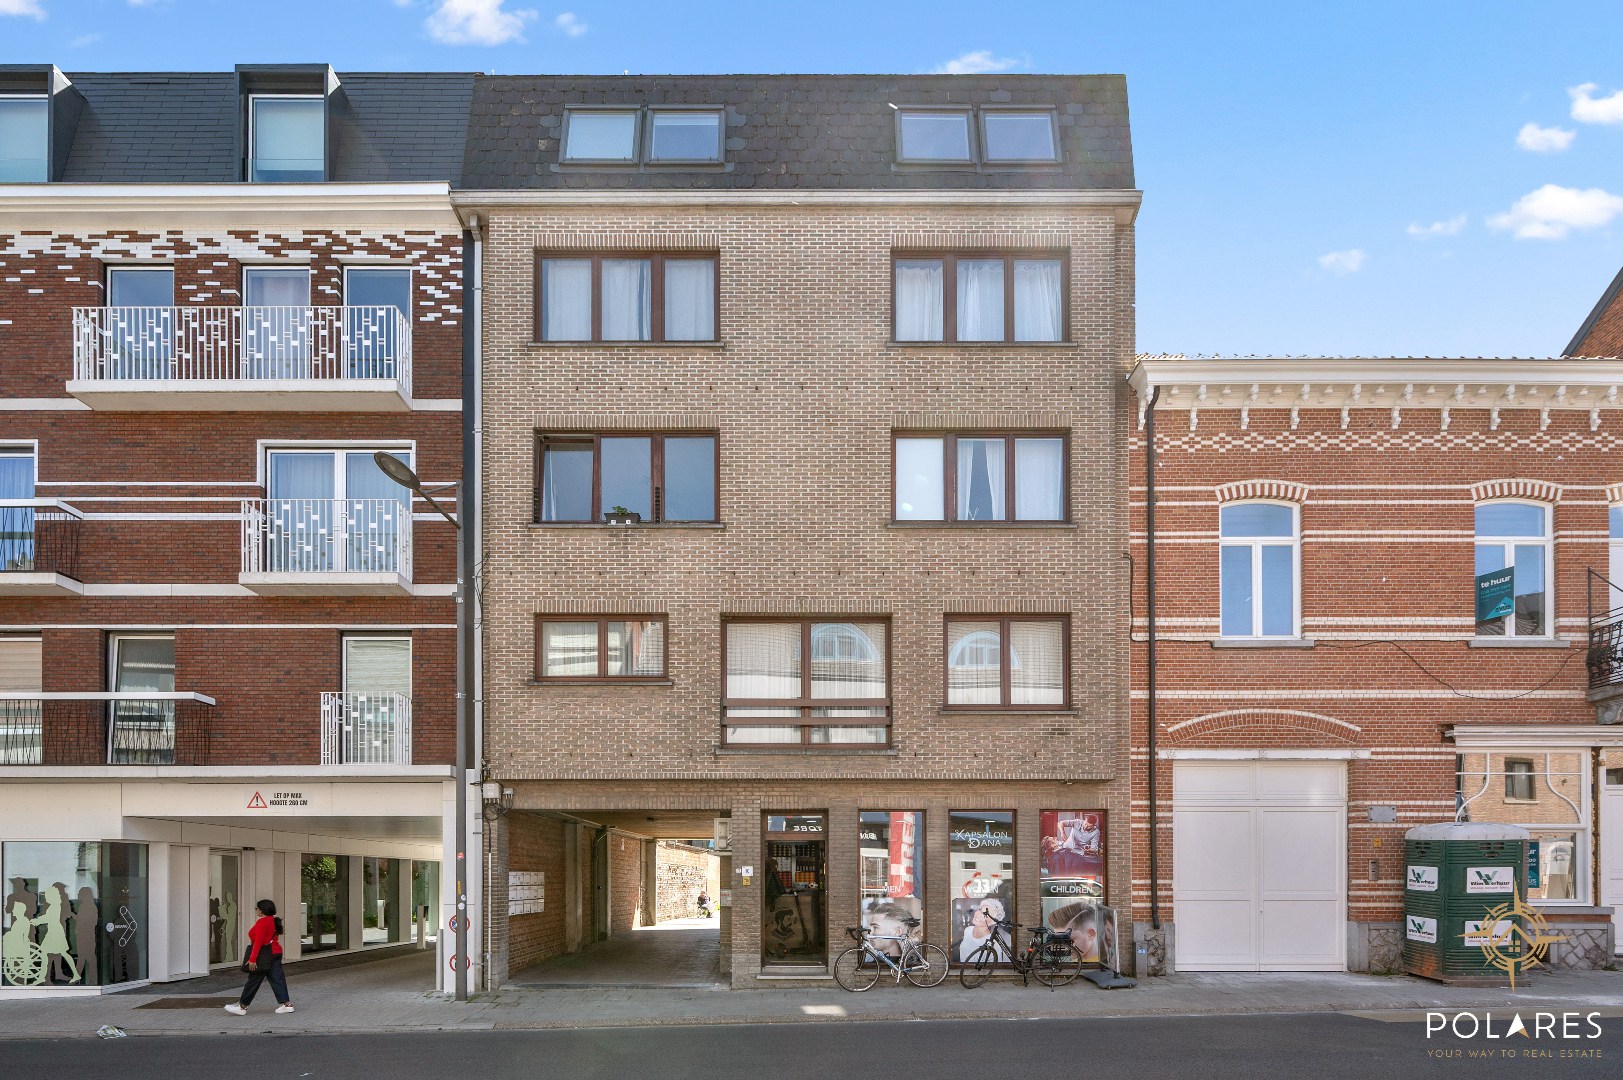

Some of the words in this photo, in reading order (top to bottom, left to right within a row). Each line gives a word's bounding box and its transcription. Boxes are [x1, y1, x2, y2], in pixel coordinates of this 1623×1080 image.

[1491, 576, 1511, 585] huur
[954, 829, 1008, 841] KAPSALON
[967, 837, 1002, 849] DANA
[1050, 885, 1094, 894] CHILDREN
